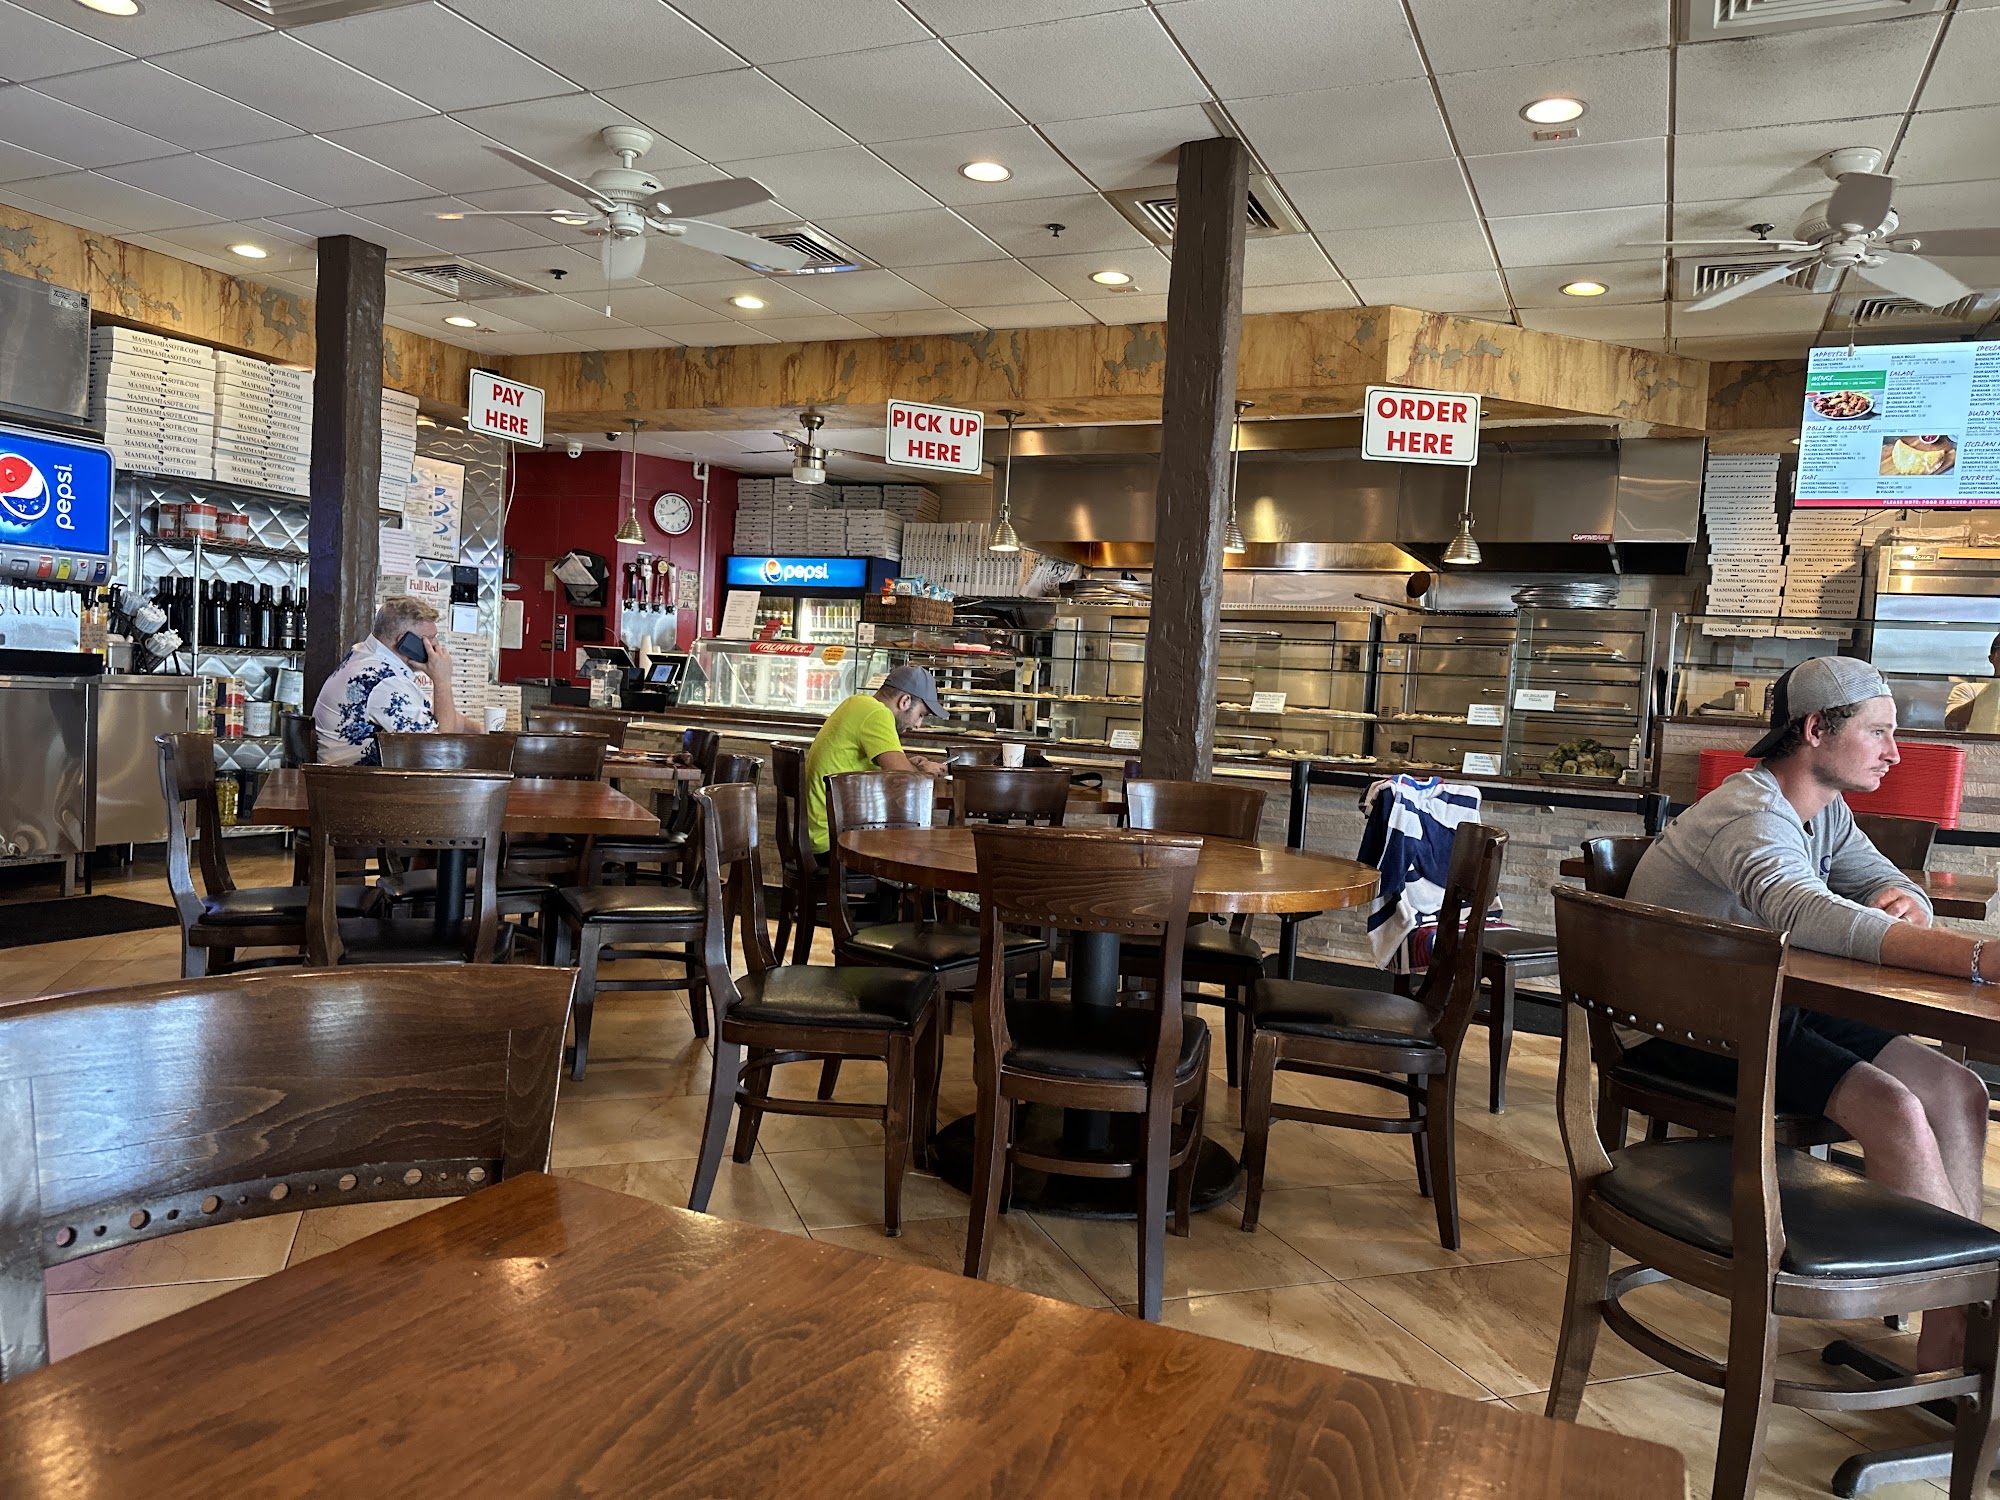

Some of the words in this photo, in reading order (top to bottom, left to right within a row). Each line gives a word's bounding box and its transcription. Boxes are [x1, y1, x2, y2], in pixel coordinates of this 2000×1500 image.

[493, 384, 524, 408] PAY
[486, 409, 528, 435] HERE
[1378, 398, 1468, 423] ORDER
[893, 410, 942, 433] PICK
[950, 418, 978, 436] UP
[908, 440, 960, 462] HERE
[1387, 431, 1453, 454] HERE
[54, 464, 76, 530] pepsi
[784, 562, 829, 582] pepsi
[410, 579, 423, 590] Full
[425, 581, 438, 592] Red
[756, 642, 790, 652] ITALIAN
